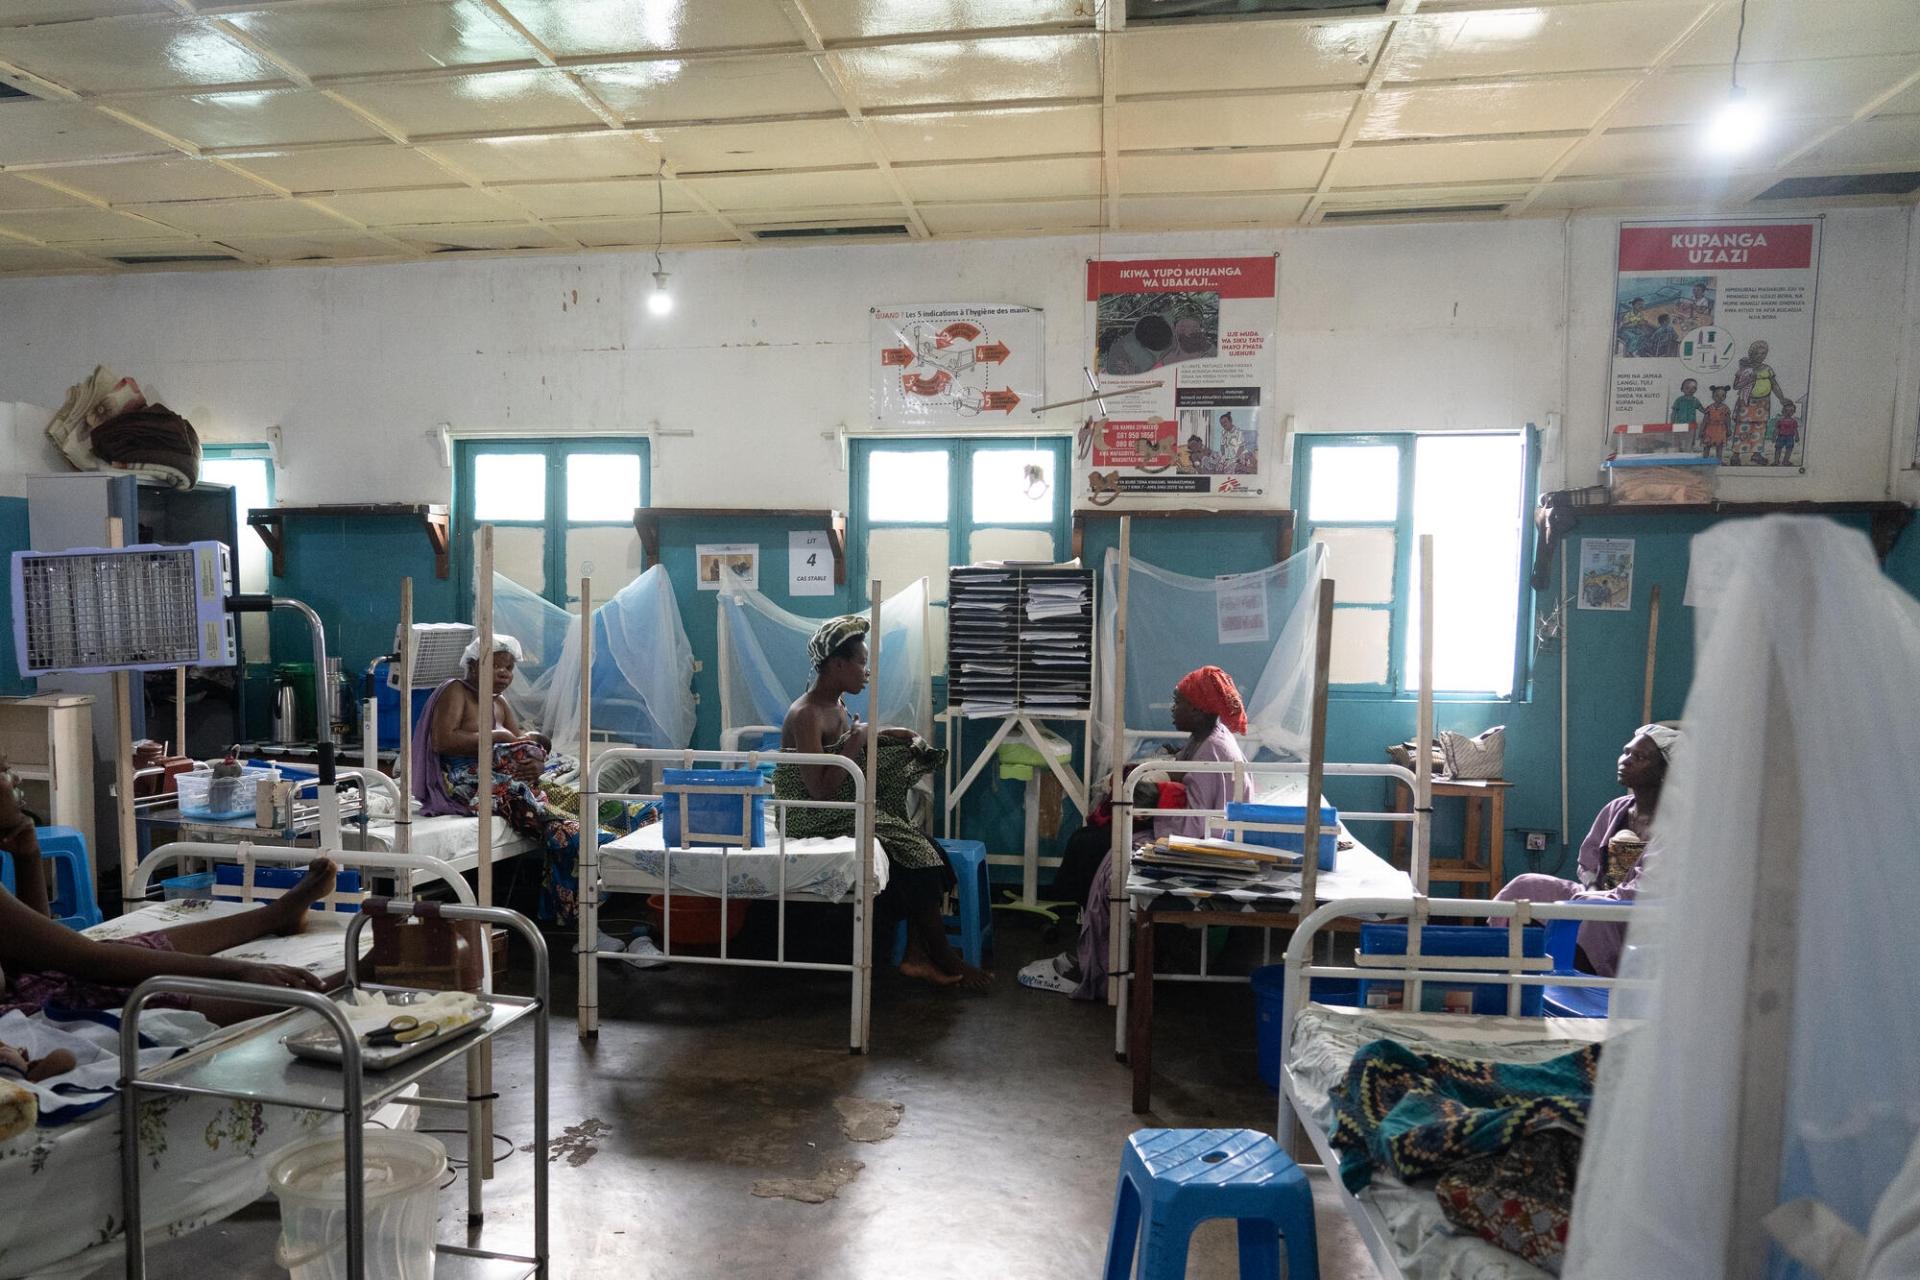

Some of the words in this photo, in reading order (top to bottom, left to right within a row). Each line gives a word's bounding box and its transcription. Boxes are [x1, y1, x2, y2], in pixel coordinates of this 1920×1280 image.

[1671, 232, 1768, 248] KUPANGA
[1688, 249, 1748, 263] UZAZI
[1120, 269, 1149, 278] IKIWA
[1153, 268, 1183, 277] YUPO
[1185, 267, 1242, 276] MUHANGA
[1142, 279, 1159, 288] WA
[875, 312, 899, 320] QUAND
[966, 308, 996, 317] l'hygiène
[977, 348, 984, 360] 4
[985, 395, 991, 407] 5
[806, 553, 816, 567] 4
